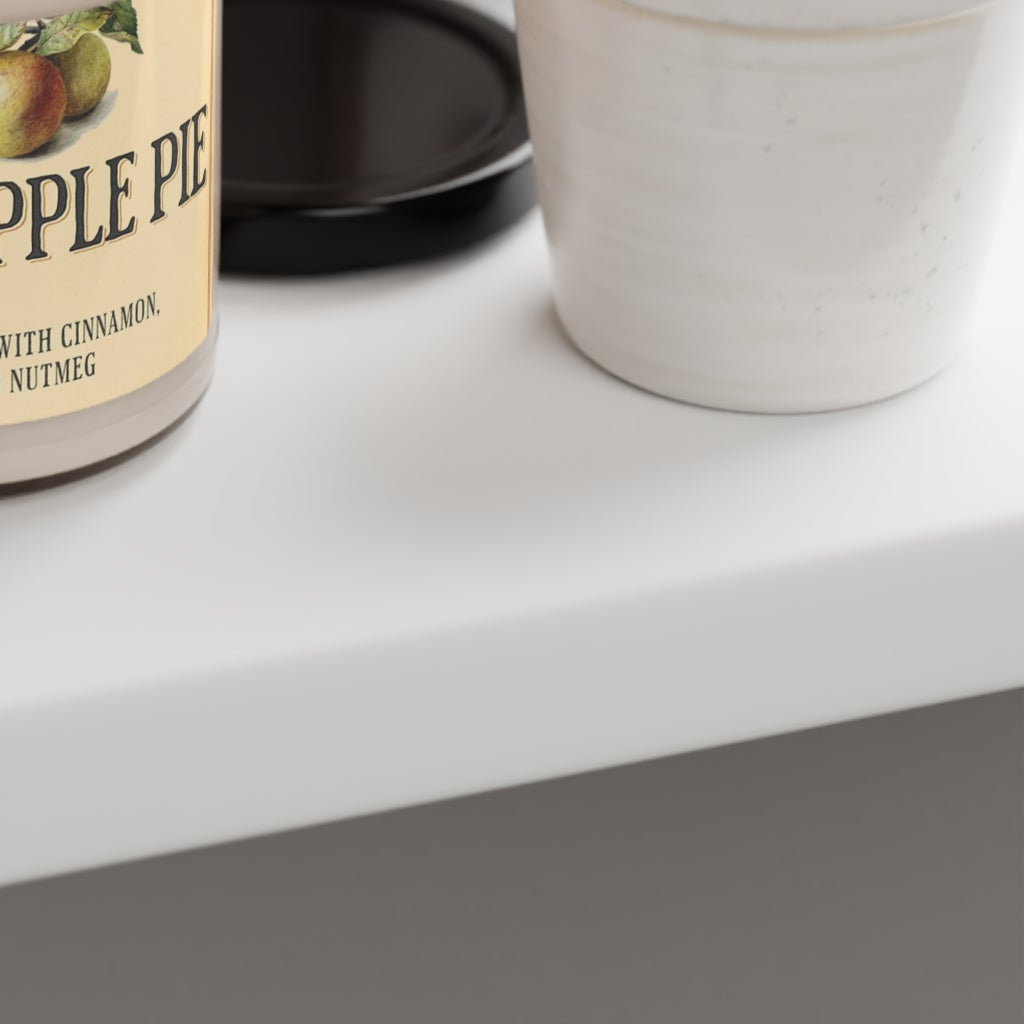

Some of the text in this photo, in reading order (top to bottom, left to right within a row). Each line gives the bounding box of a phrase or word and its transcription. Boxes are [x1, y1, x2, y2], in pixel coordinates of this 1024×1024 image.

[149, 103, 208, 224] PIE
[60, 291, 161, 349] CINNAMON,
[9, 351, 96, 394] NUTMEG
